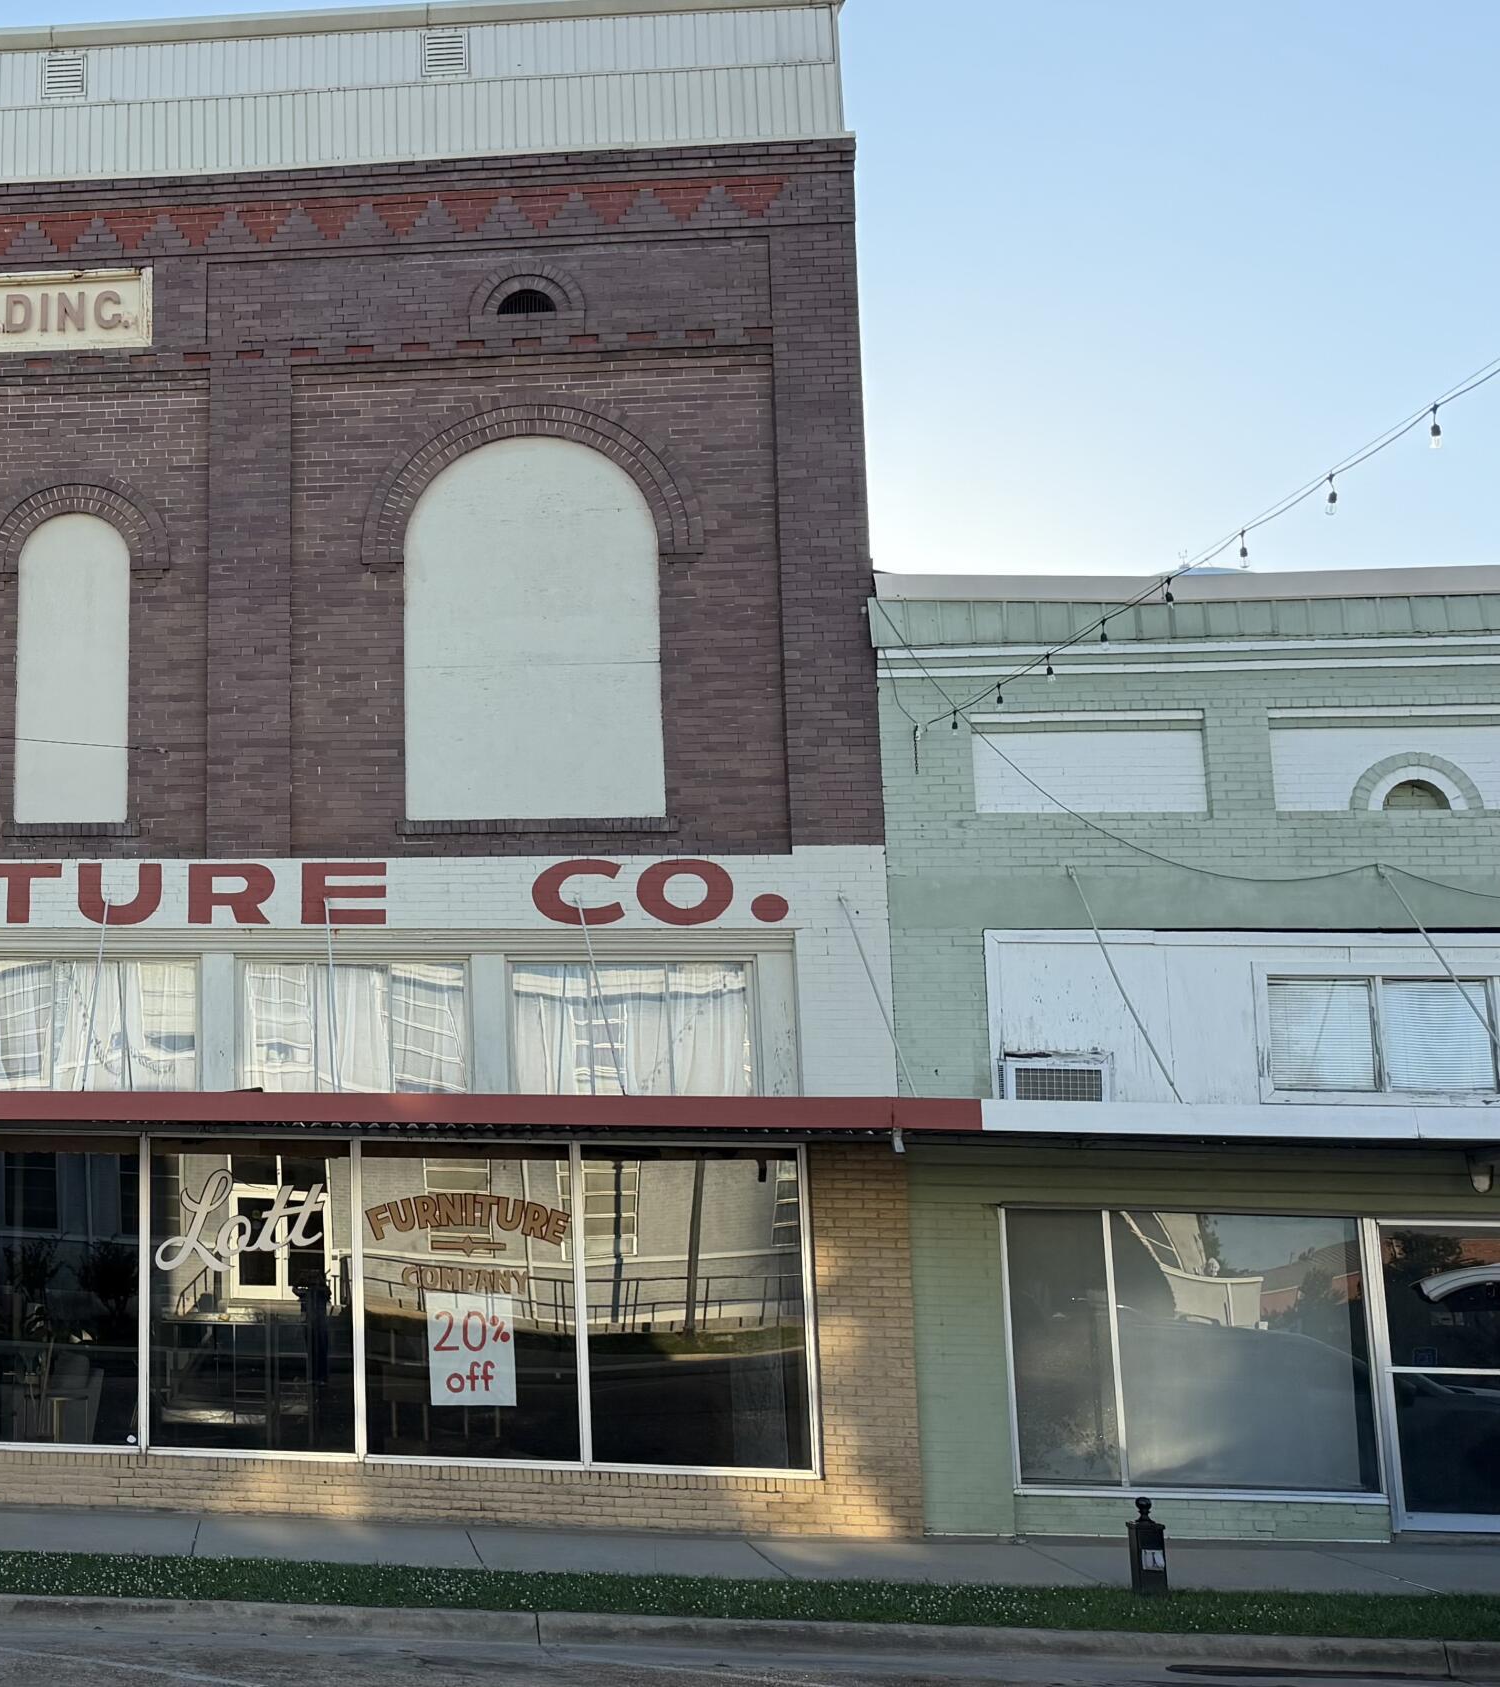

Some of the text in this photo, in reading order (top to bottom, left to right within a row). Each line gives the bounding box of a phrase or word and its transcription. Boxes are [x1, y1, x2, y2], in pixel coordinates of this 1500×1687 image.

[531, 858, 791, 926] CO.
[155, 1168, 327, 1272] Lott
[365, 1193, 572, 1247] FURNITURE
[402, 1264, 530, 1294] COMPANY
[433, 1310, 510, 1352] 20%
[445, 1360, 495, 1393] off
